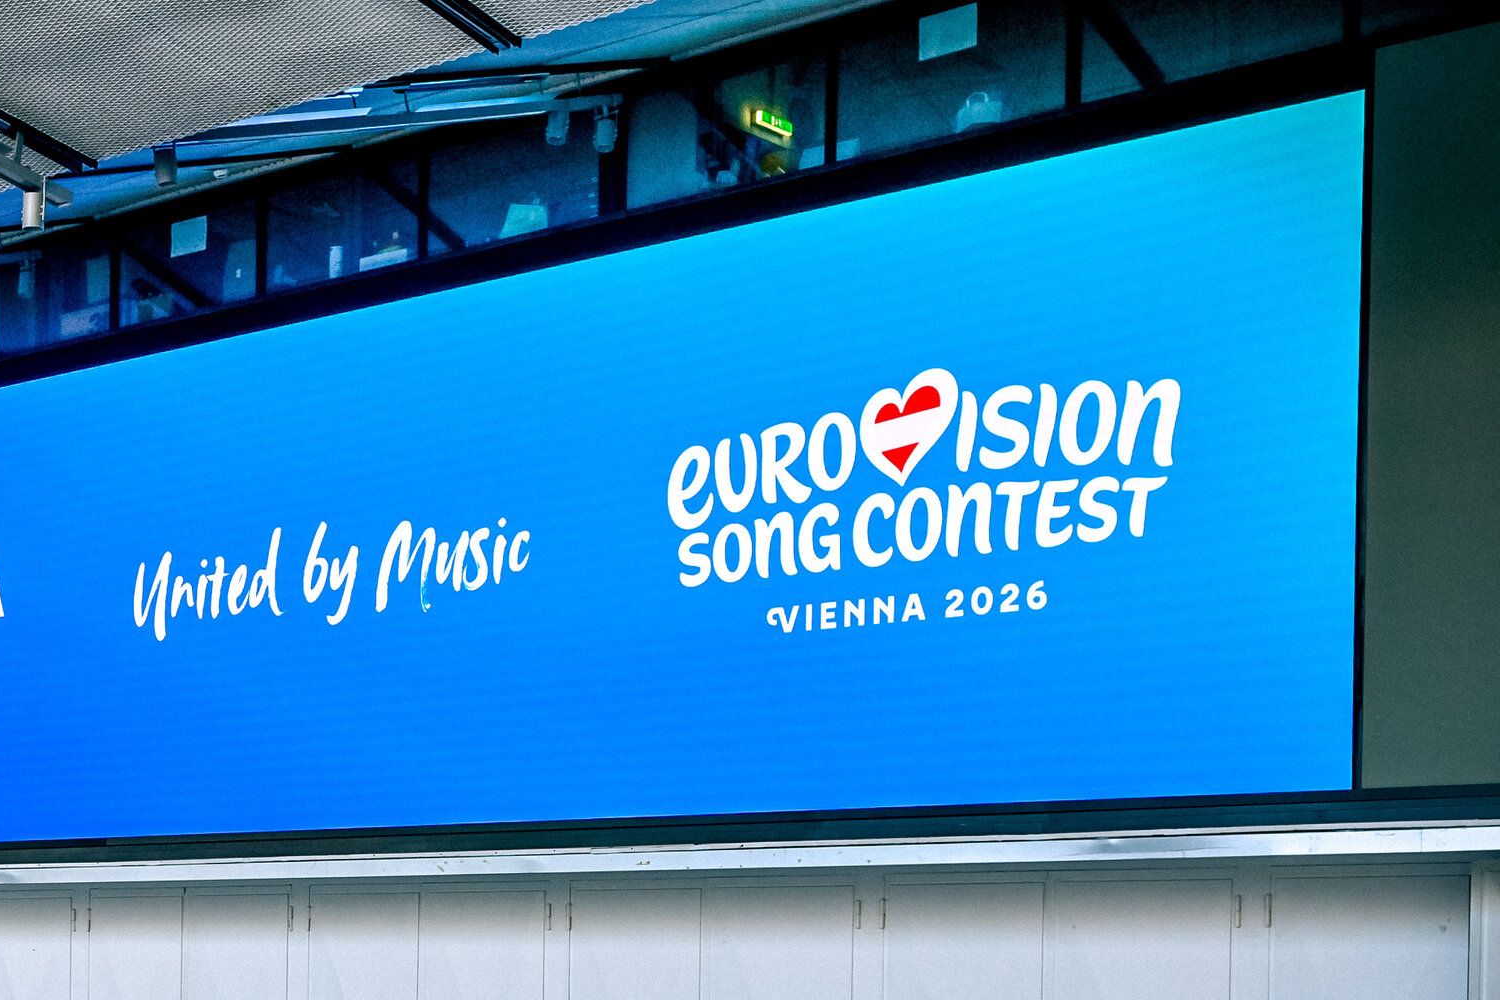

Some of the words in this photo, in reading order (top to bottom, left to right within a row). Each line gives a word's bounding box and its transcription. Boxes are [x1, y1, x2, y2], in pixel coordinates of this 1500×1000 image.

[667, 367, 1181, 531] EUROVISION
[133, 526, 285, 642] United
[302, 521, 358, 626] by
[375, 517, 531, 613] Music
[678, 503, 841, 588] SONG
[852, 476, 1168, 568] CONTEST
[766, 592, 926, 634] VIENNA
[945, 580, 1049, 619] 2026
